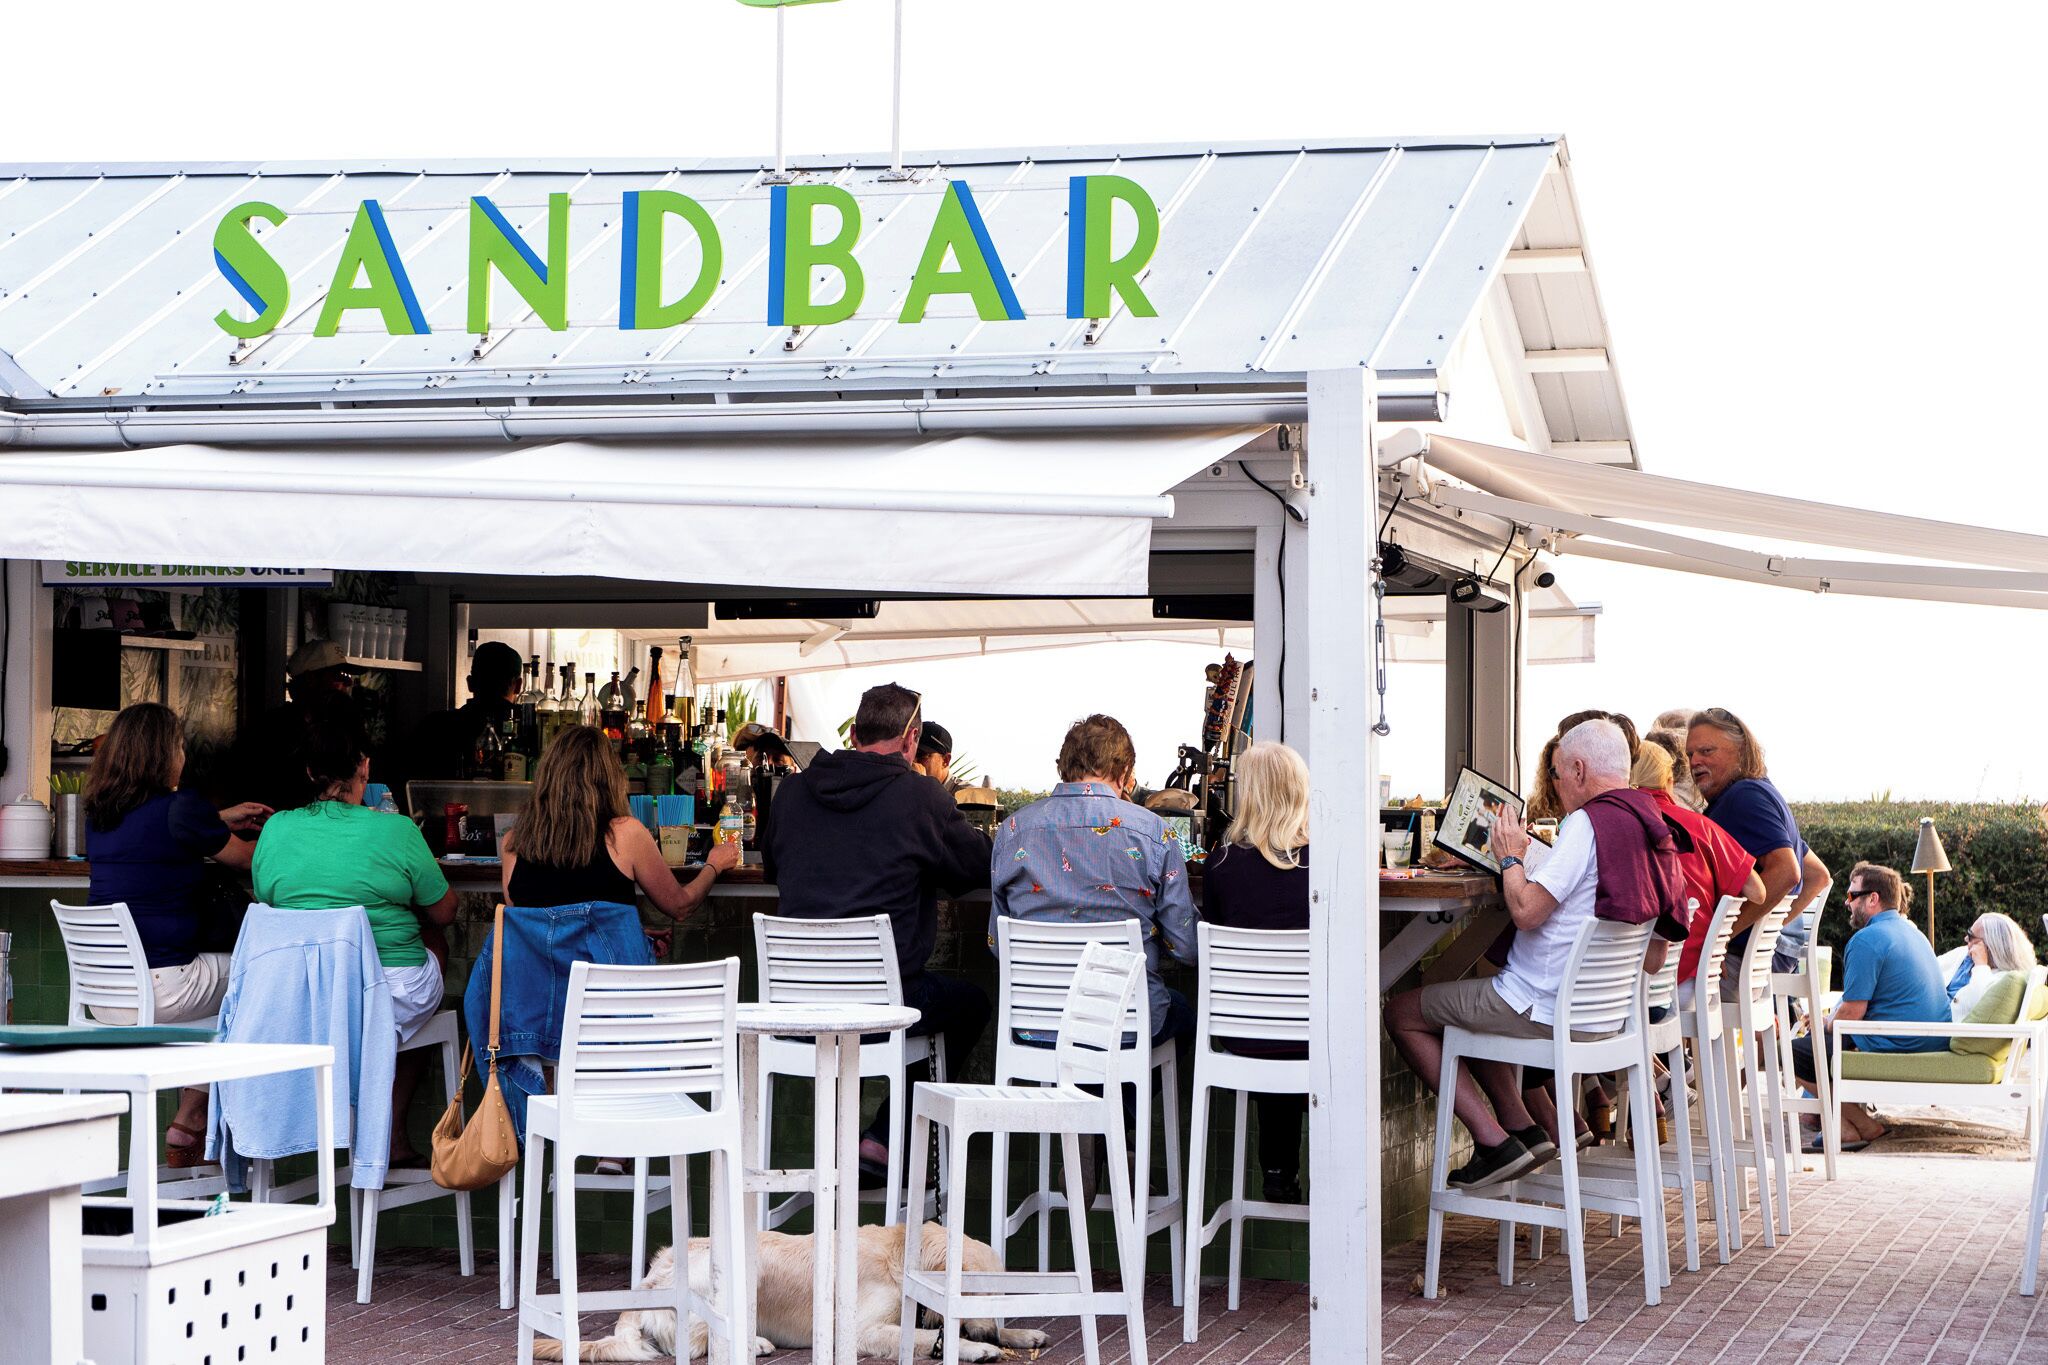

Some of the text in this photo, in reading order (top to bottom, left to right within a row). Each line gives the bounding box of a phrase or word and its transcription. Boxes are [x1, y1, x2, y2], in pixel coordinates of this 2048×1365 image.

[213, 175, 1159, 337] SANDBAR
[65, 561, 156, 577] SERVICE
[161, 564, 246, 577] DRINKS
[183, 644, 230, 662] NDBAR
